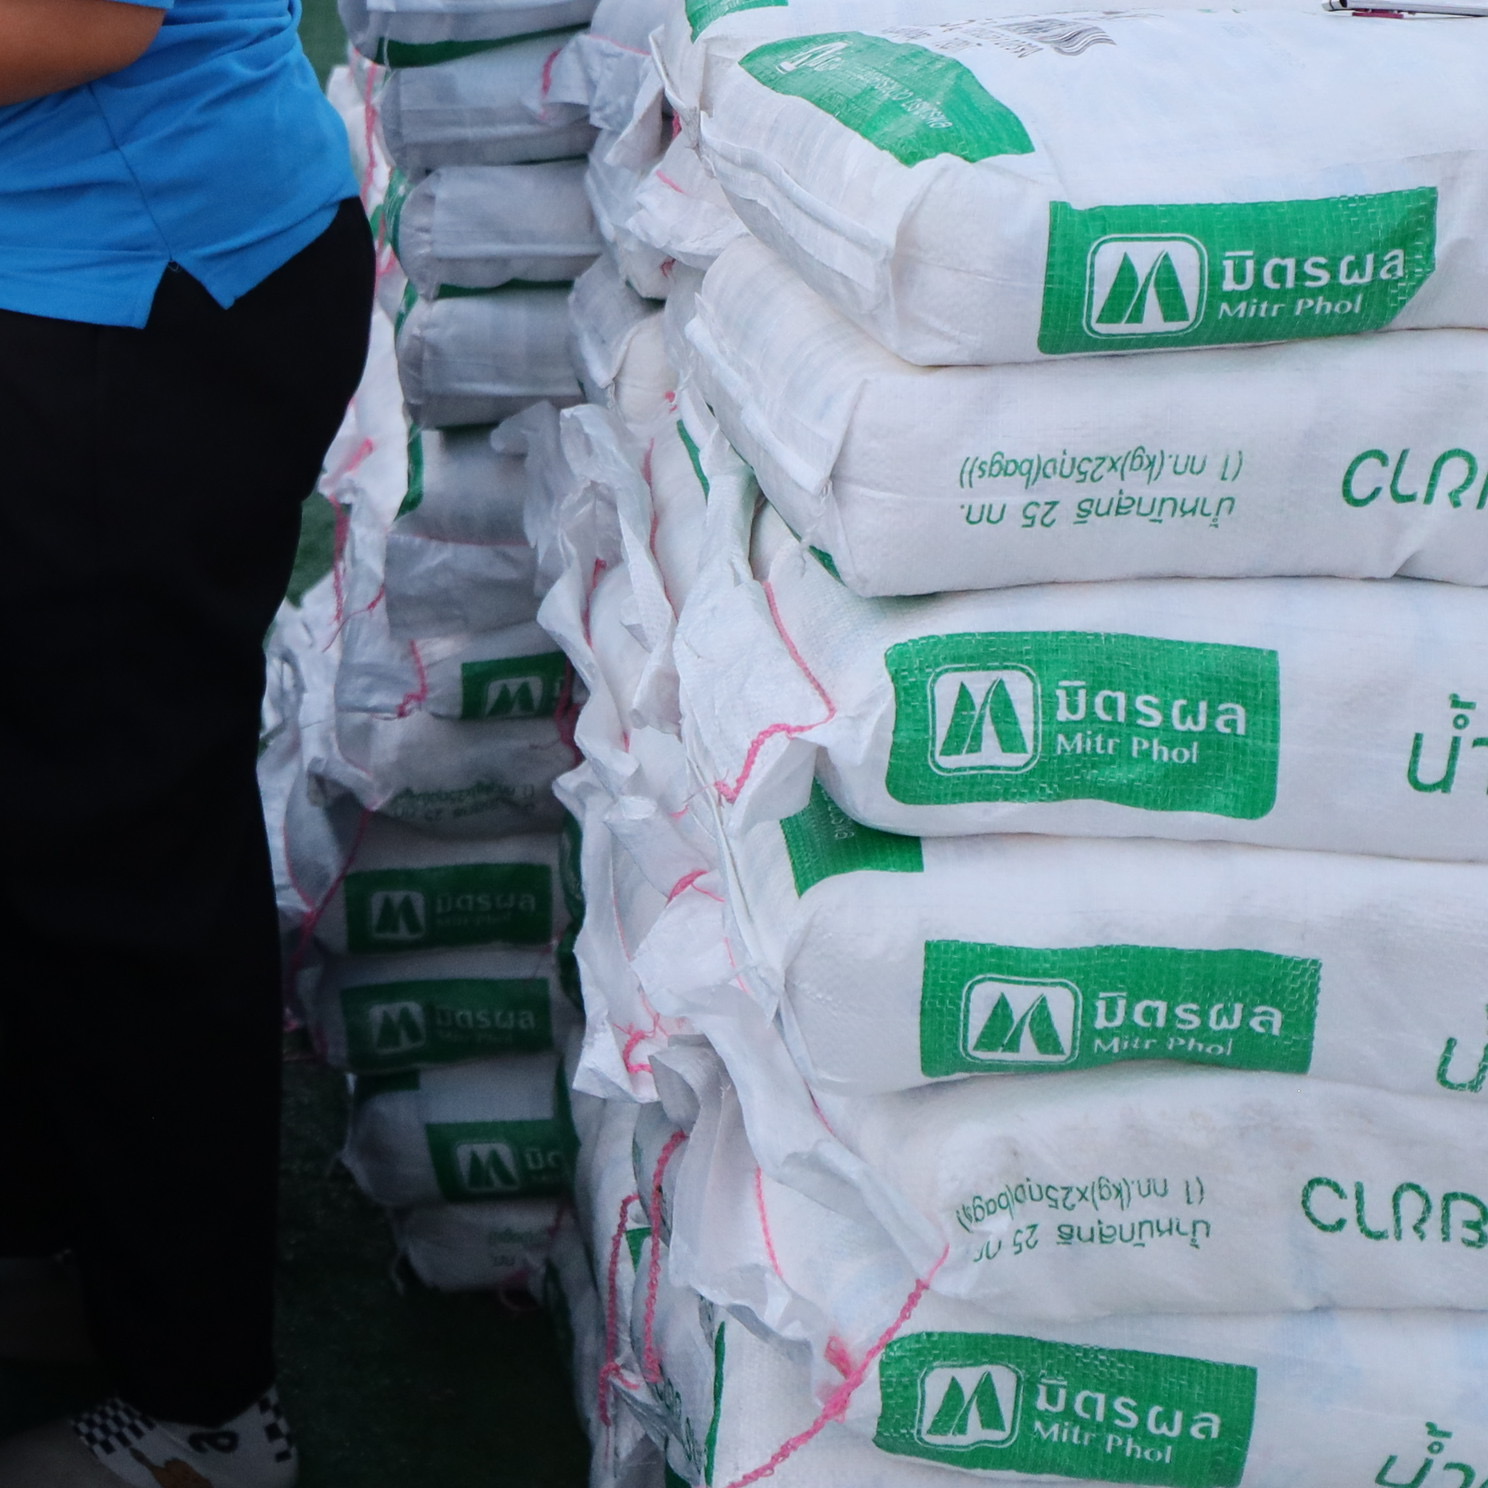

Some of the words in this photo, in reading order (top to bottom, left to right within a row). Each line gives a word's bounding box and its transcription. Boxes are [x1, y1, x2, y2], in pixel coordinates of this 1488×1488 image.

[1222, 250, 1405, 291] มิตรผล
[1218, 298, 1284, 319] Mitr
[1294, 291, 1364, 315] Phol
[960, 503, 1007, 526] กก.
[1022, 501, 1060, 527] 25
[1074, 490, 1236, 528] น้ำหนักสุทธิ
[1054, 679, 1247, 735] มิตรผล
[1054, 731, 1122, 757] Mitr
[1131, 737, 1200, 765] Phol
[1094, 990, 1283, 1038] มิตรผล
[1093, 1035, 1159, 1057] Mitr
[1166, 1036, 1234, 1058] Phol
[1012, 1224, 1041, 1255] 25
[1033, 1378, 1222, 1441] มิตรผล
[1032, 1418, 1099, 1447] Mitr
[1104, 1432, 1174, 1464] Phol
